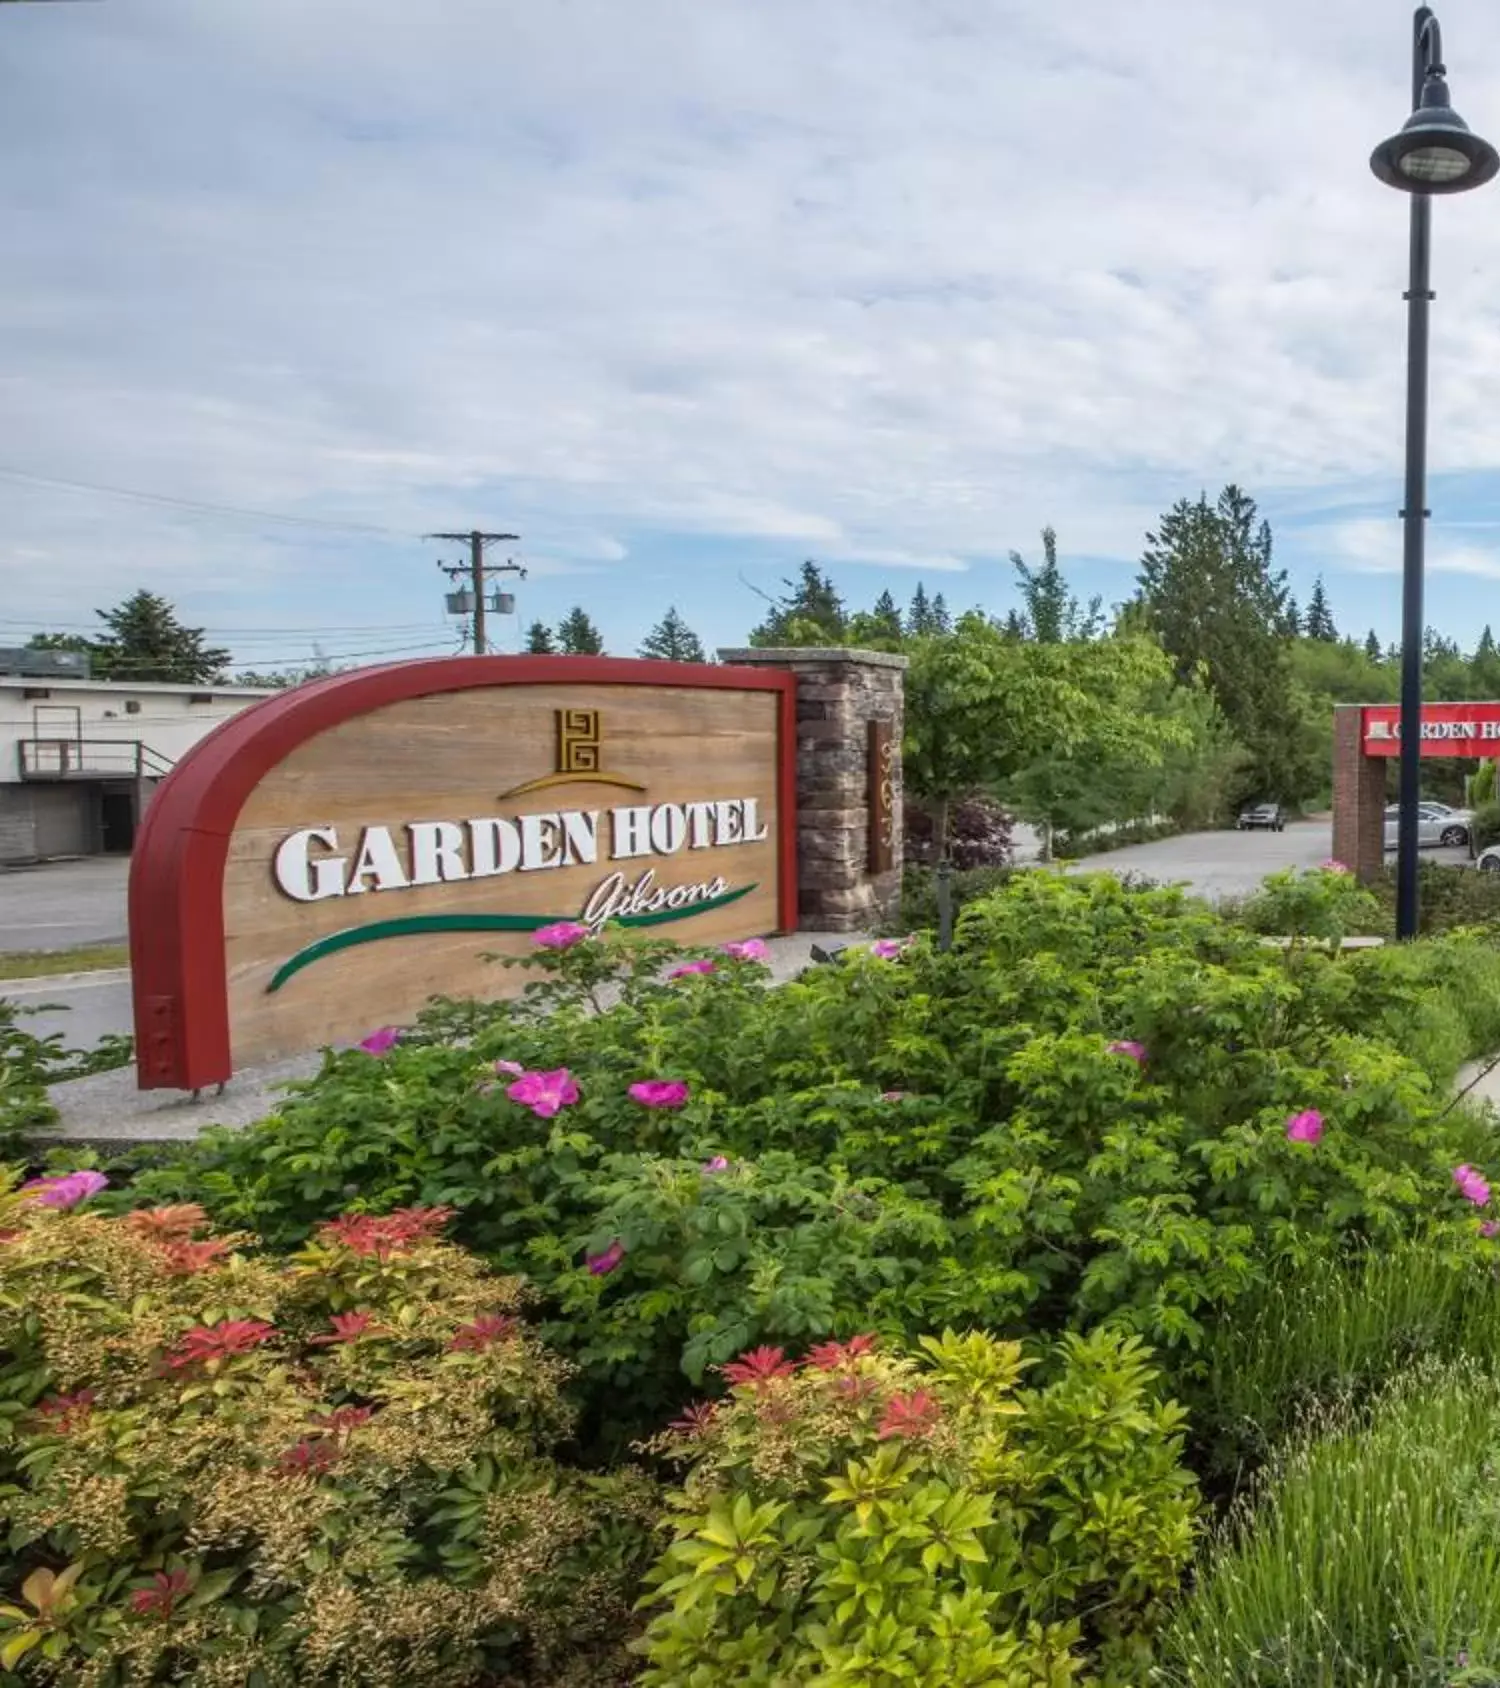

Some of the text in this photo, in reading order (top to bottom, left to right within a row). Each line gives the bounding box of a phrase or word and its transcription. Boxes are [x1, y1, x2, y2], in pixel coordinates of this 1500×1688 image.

[1392, 720, 1476, 740] GRDEN
[272, 798, 768, 901] GARDEN HOTEL
[582, 867, 729, 939] Gibsons
